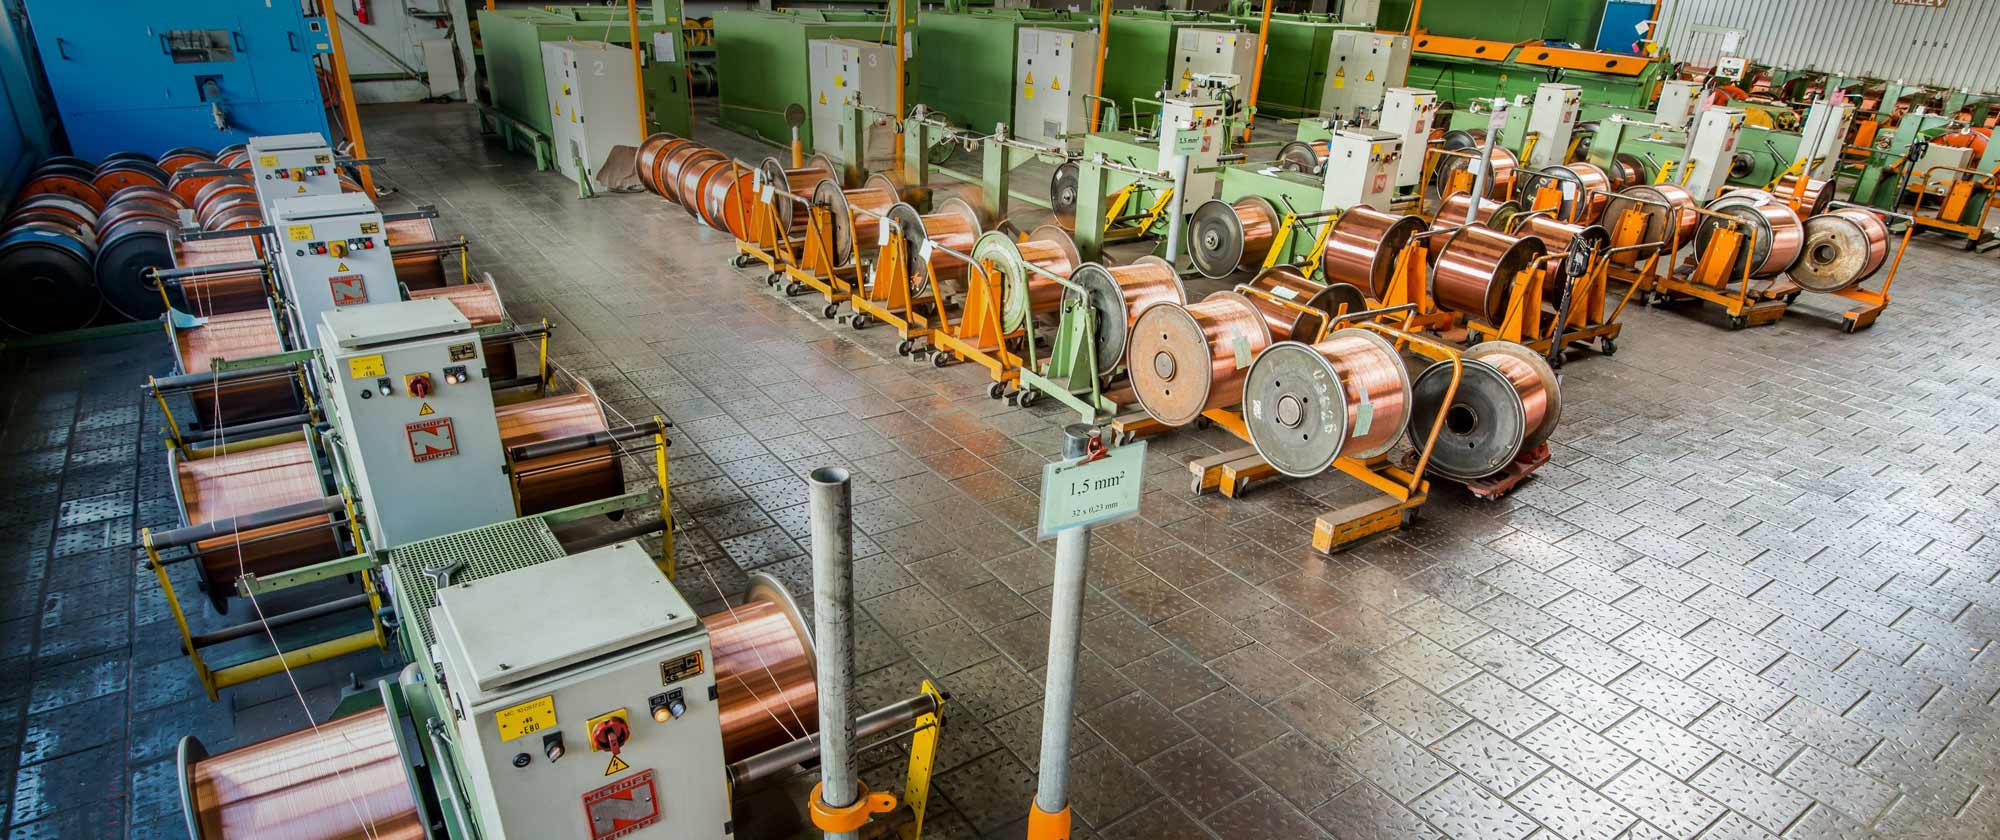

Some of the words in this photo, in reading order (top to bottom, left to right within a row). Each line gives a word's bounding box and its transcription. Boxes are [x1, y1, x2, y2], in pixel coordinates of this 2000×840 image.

[593, 61, 605, 76] 2
[868, 54, 878, 67] 3
[1070, 478, 1090, 496] 1,5
[1094, 470, 1125, 490] mm²
[1072, 509, 1081, 518] 32
[1088, 503, 1104, 514] 0,23
[1105, 501, 1118, 510] mm
[584, 772, 653, 804] NIEHOFF
